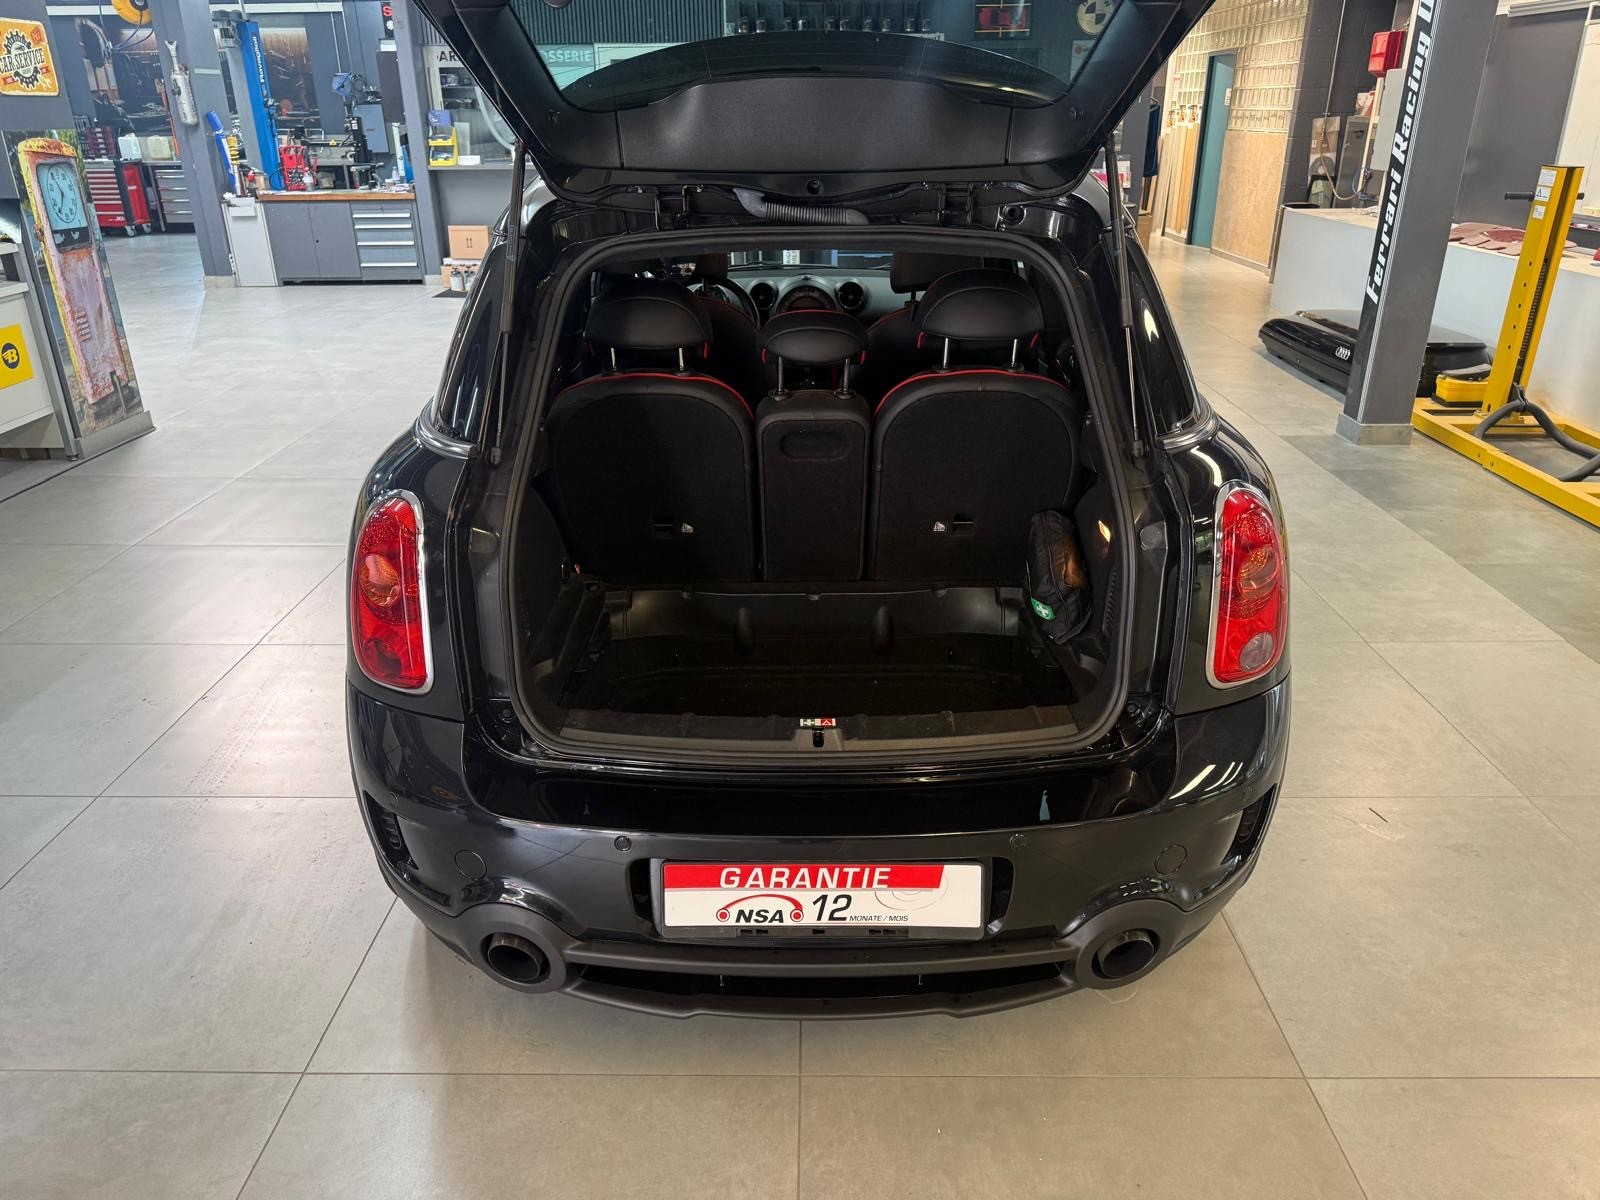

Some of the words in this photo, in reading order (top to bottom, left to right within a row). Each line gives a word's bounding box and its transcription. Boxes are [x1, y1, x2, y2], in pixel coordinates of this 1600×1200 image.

[14, 47, 45, 70] SERVICE
[1366, 168, 1402, 305] Ferrari
[1392, 31, 1431, 165] Racing
[720, 867, 891, 889] GARANTIE
[735, 909, 784, 923] NSA
[812, 894, 852, 921] 12
